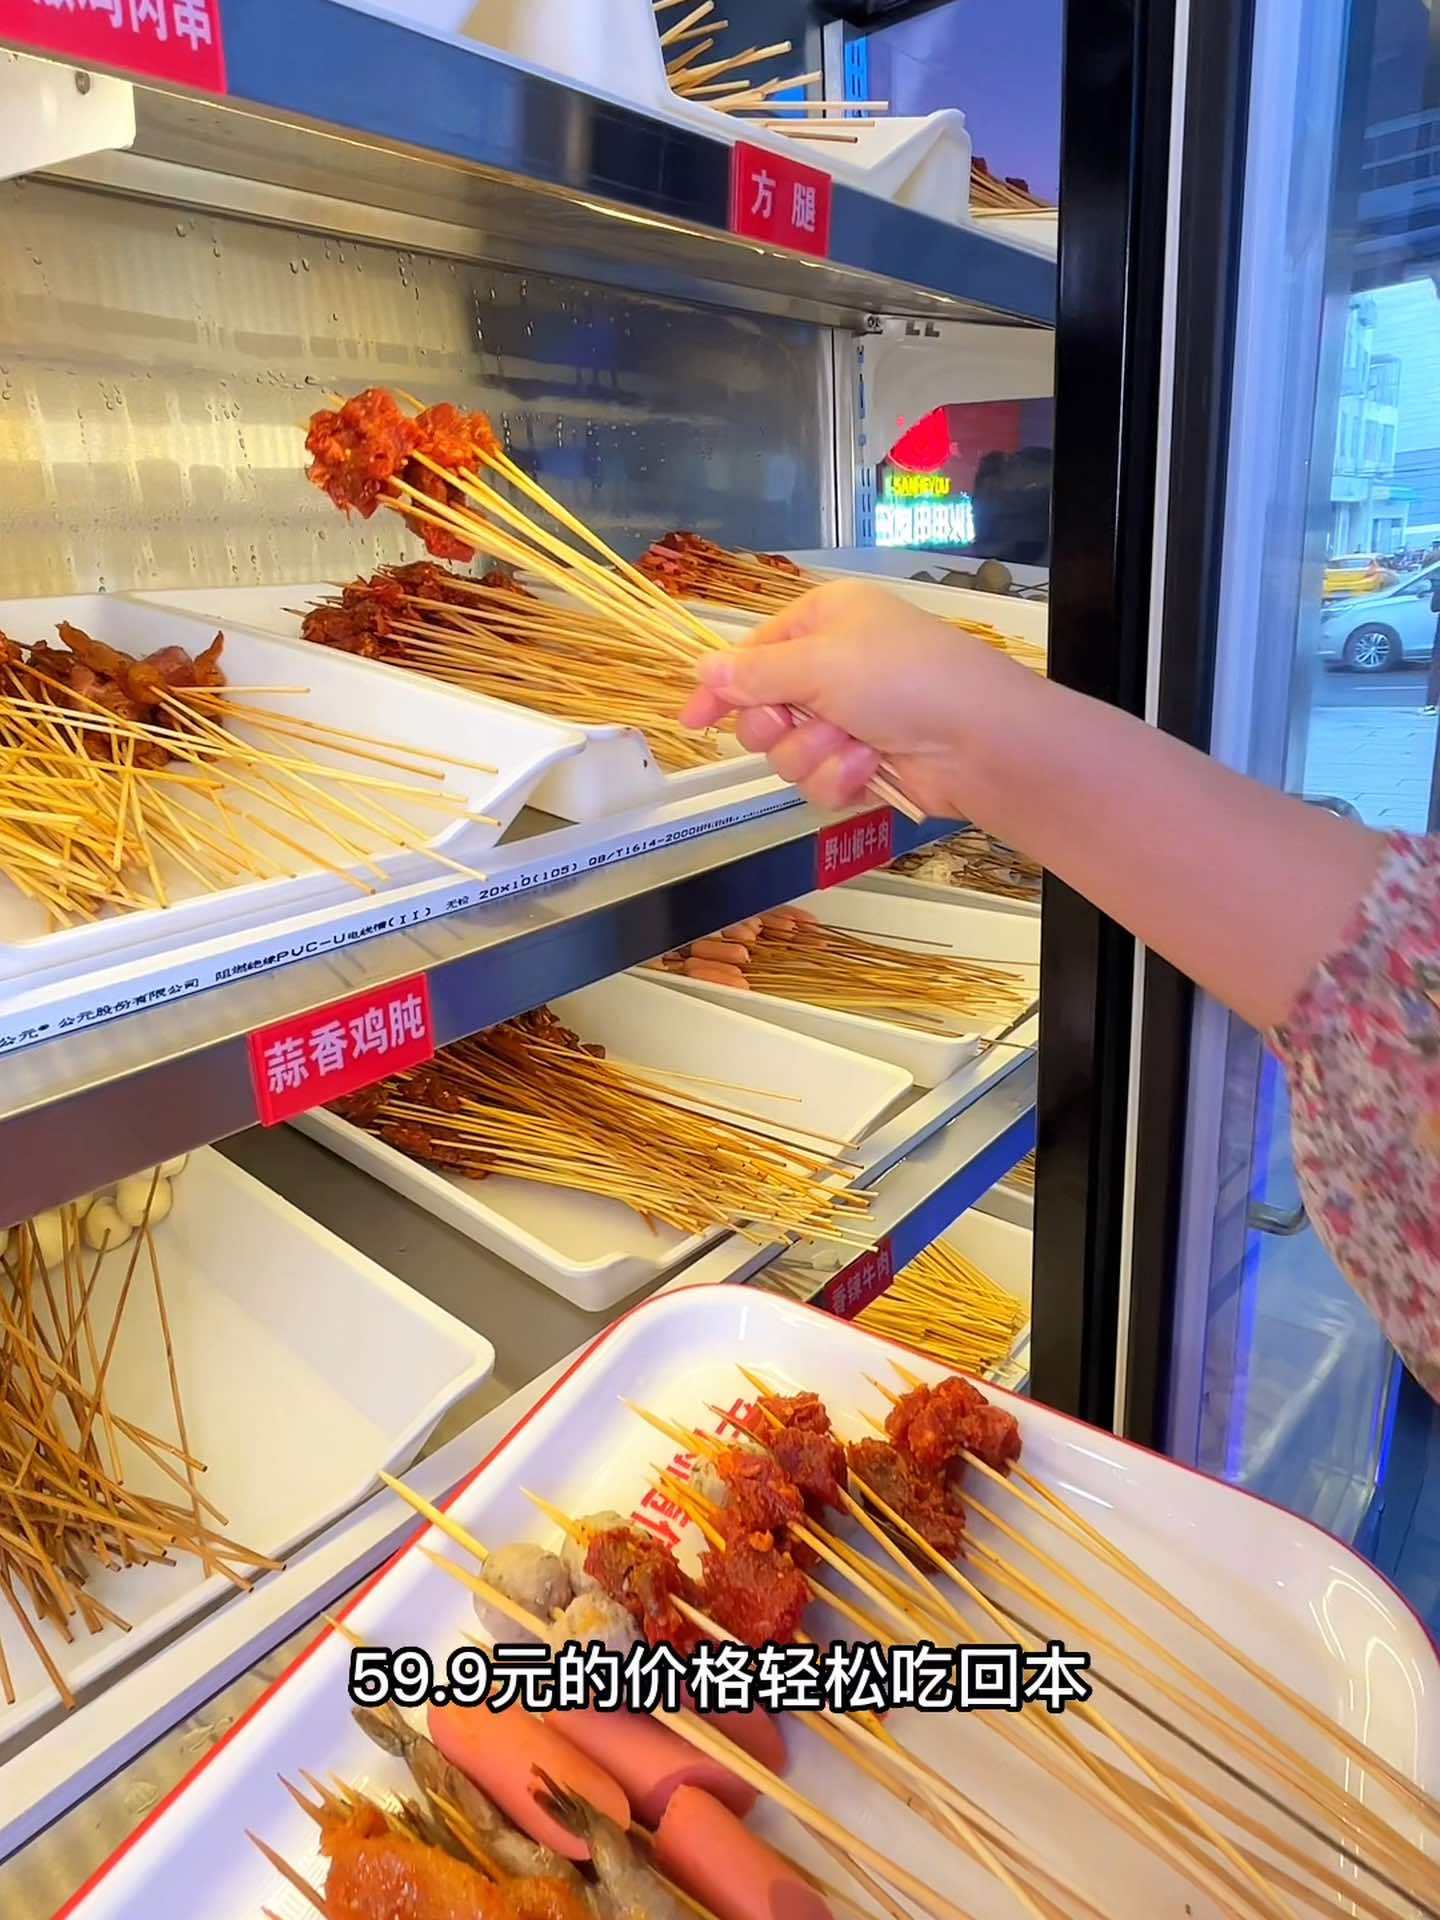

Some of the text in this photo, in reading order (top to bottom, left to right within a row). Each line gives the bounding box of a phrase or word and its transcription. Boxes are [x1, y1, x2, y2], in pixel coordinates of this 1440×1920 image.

[751, 169, 817, 233] 方腿
[263, 993, 426, 1095] 蒜香鸡肫
